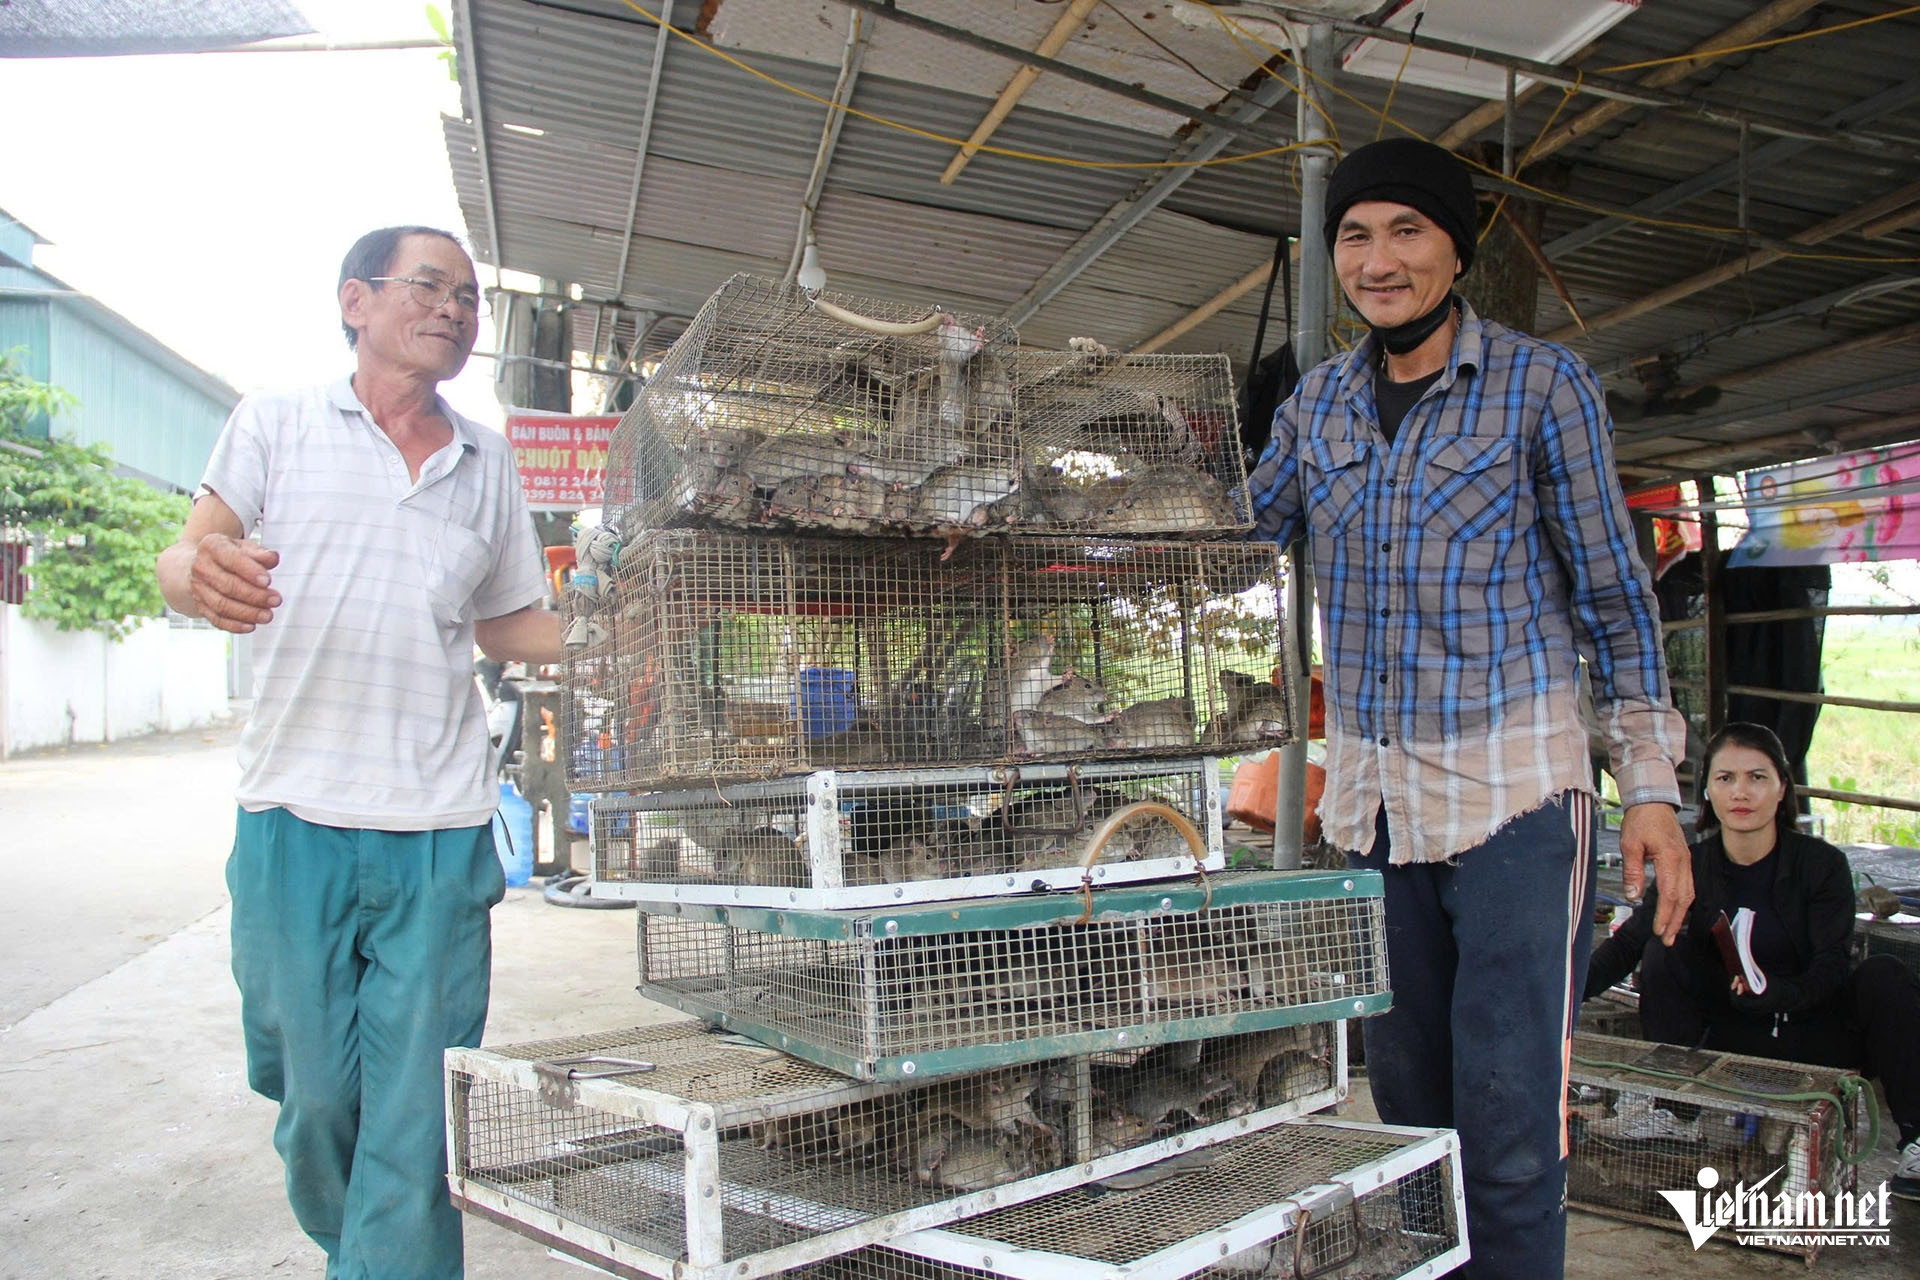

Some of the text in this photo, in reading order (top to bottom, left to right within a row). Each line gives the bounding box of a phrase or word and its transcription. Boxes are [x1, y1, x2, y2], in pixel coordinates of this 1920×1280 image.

[511, 424, 536, 440] BÁN
[539, 424, 570, 441] BUÔN
[514, 445, 571, 472] CHUỘT
